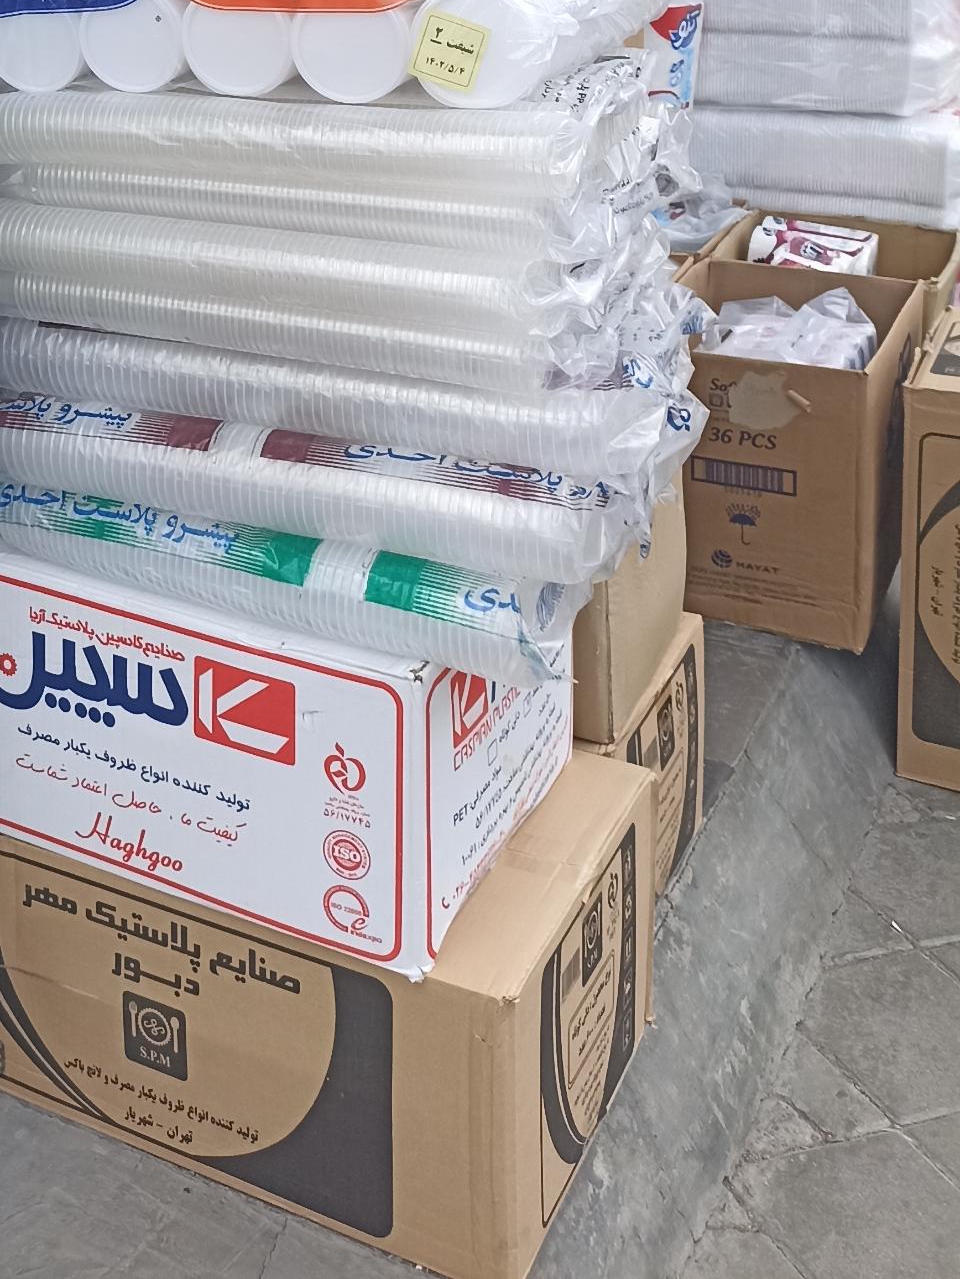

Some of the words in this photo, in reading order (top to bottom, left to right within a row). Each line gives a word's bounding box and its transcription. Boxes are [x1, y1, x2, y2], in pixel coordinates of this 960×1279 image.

[708, 426, 733, 444] 36
[738, 430, 777, 450] PCS
[161, 513, 240, 555] پیشرو
[736, 561, 780, 574] HAYAT
[17, 723, 61, 746] مصرف
[63, 738, 92, 760] یکبار
[15, 752, 69, 782] شماست
[94, 749, 137, 772] ظروف
[140, 765, 170, 784] انواع
[71, 776, 107, 796] اعتماد
[172, 777, 212, 796] کننده
[111, 790, 163, 814] حاصل
[215, 790, 251, 813] تولید
[452, 803, 469, 827] PET
[74, 811, 184, 872] Haghgoo
[196, 816, 248, 848] کیفیت
[333, 844, 362, 864] ISO
[85, 900, 201, 973] پلاستیک
[209, 948, 301, 994] صنایع
[139, 1045, 172, 1069] S.P.M
[110, 1075, 136, 1093] مصرف
[137, 1085, 157, 1104] یکبار
[158, 1094, 185, 1113] ظروف
[186, 1105, 209, 1123] انواع
[124, 1106, 154, 1127] شهریار
[210, 1114, 235, 1131] کننده
[166, 1125, 194, 1145] تهران
[236, 1125, 260, 1144] تولید
